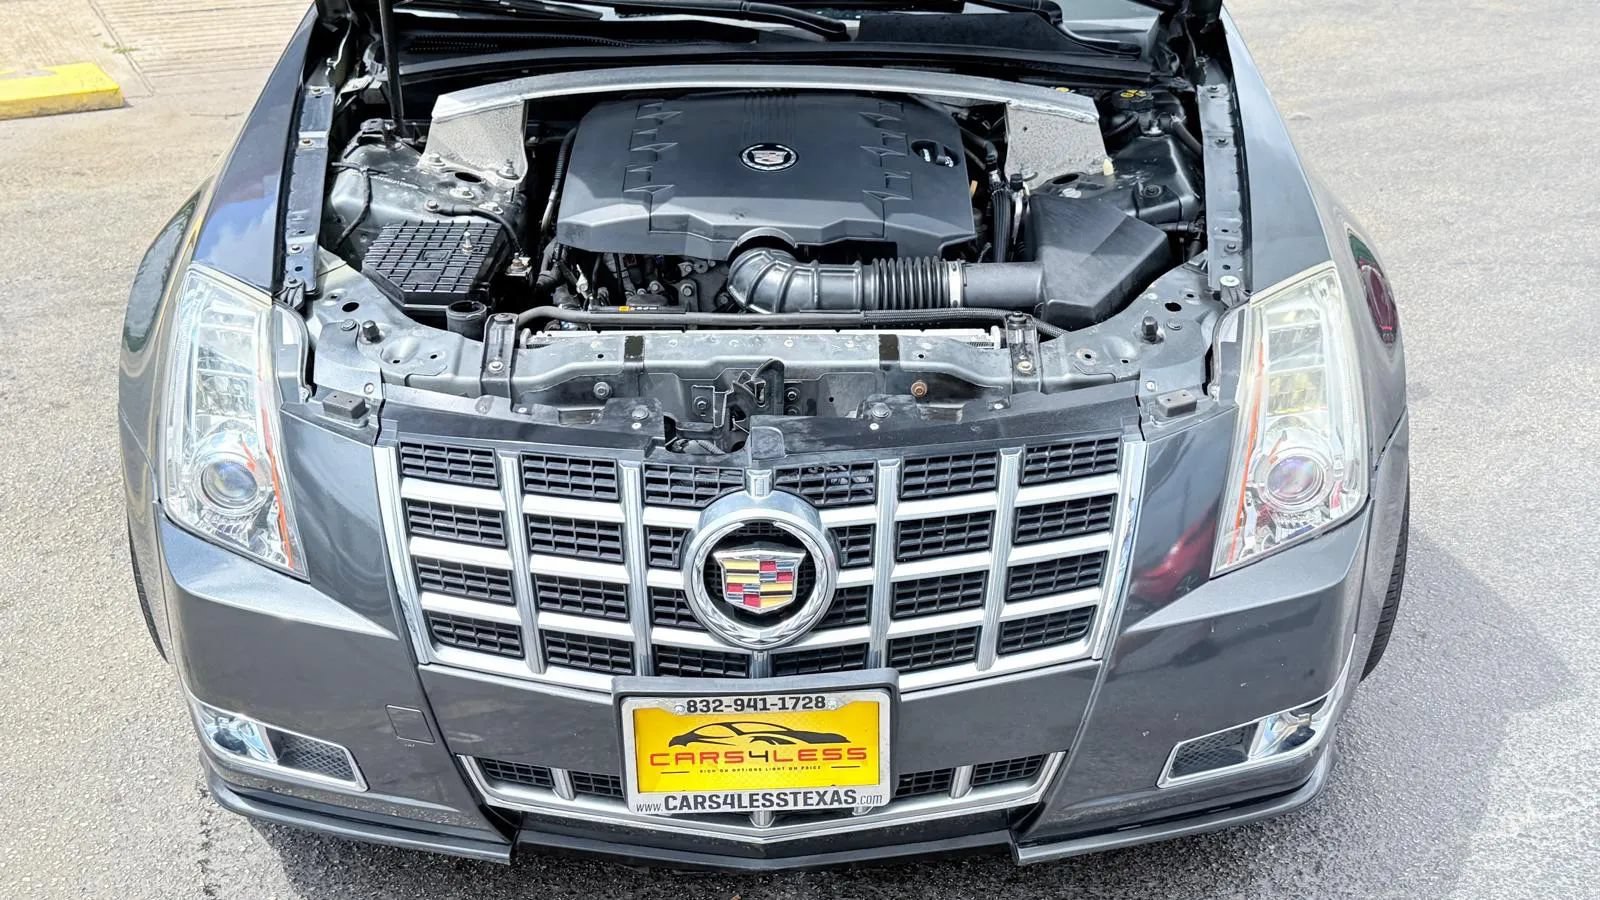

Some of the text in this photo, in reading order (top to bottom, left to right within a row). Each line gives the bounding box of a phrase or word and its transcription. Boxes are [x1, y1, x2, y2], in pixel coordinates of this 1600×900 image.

[686, 696, 826, 714] 832-941-1728
[650, 747, 867, 767] CARS4LESS
[636, 789, 883, 813] www.CARS4LESSTEXAS.com
